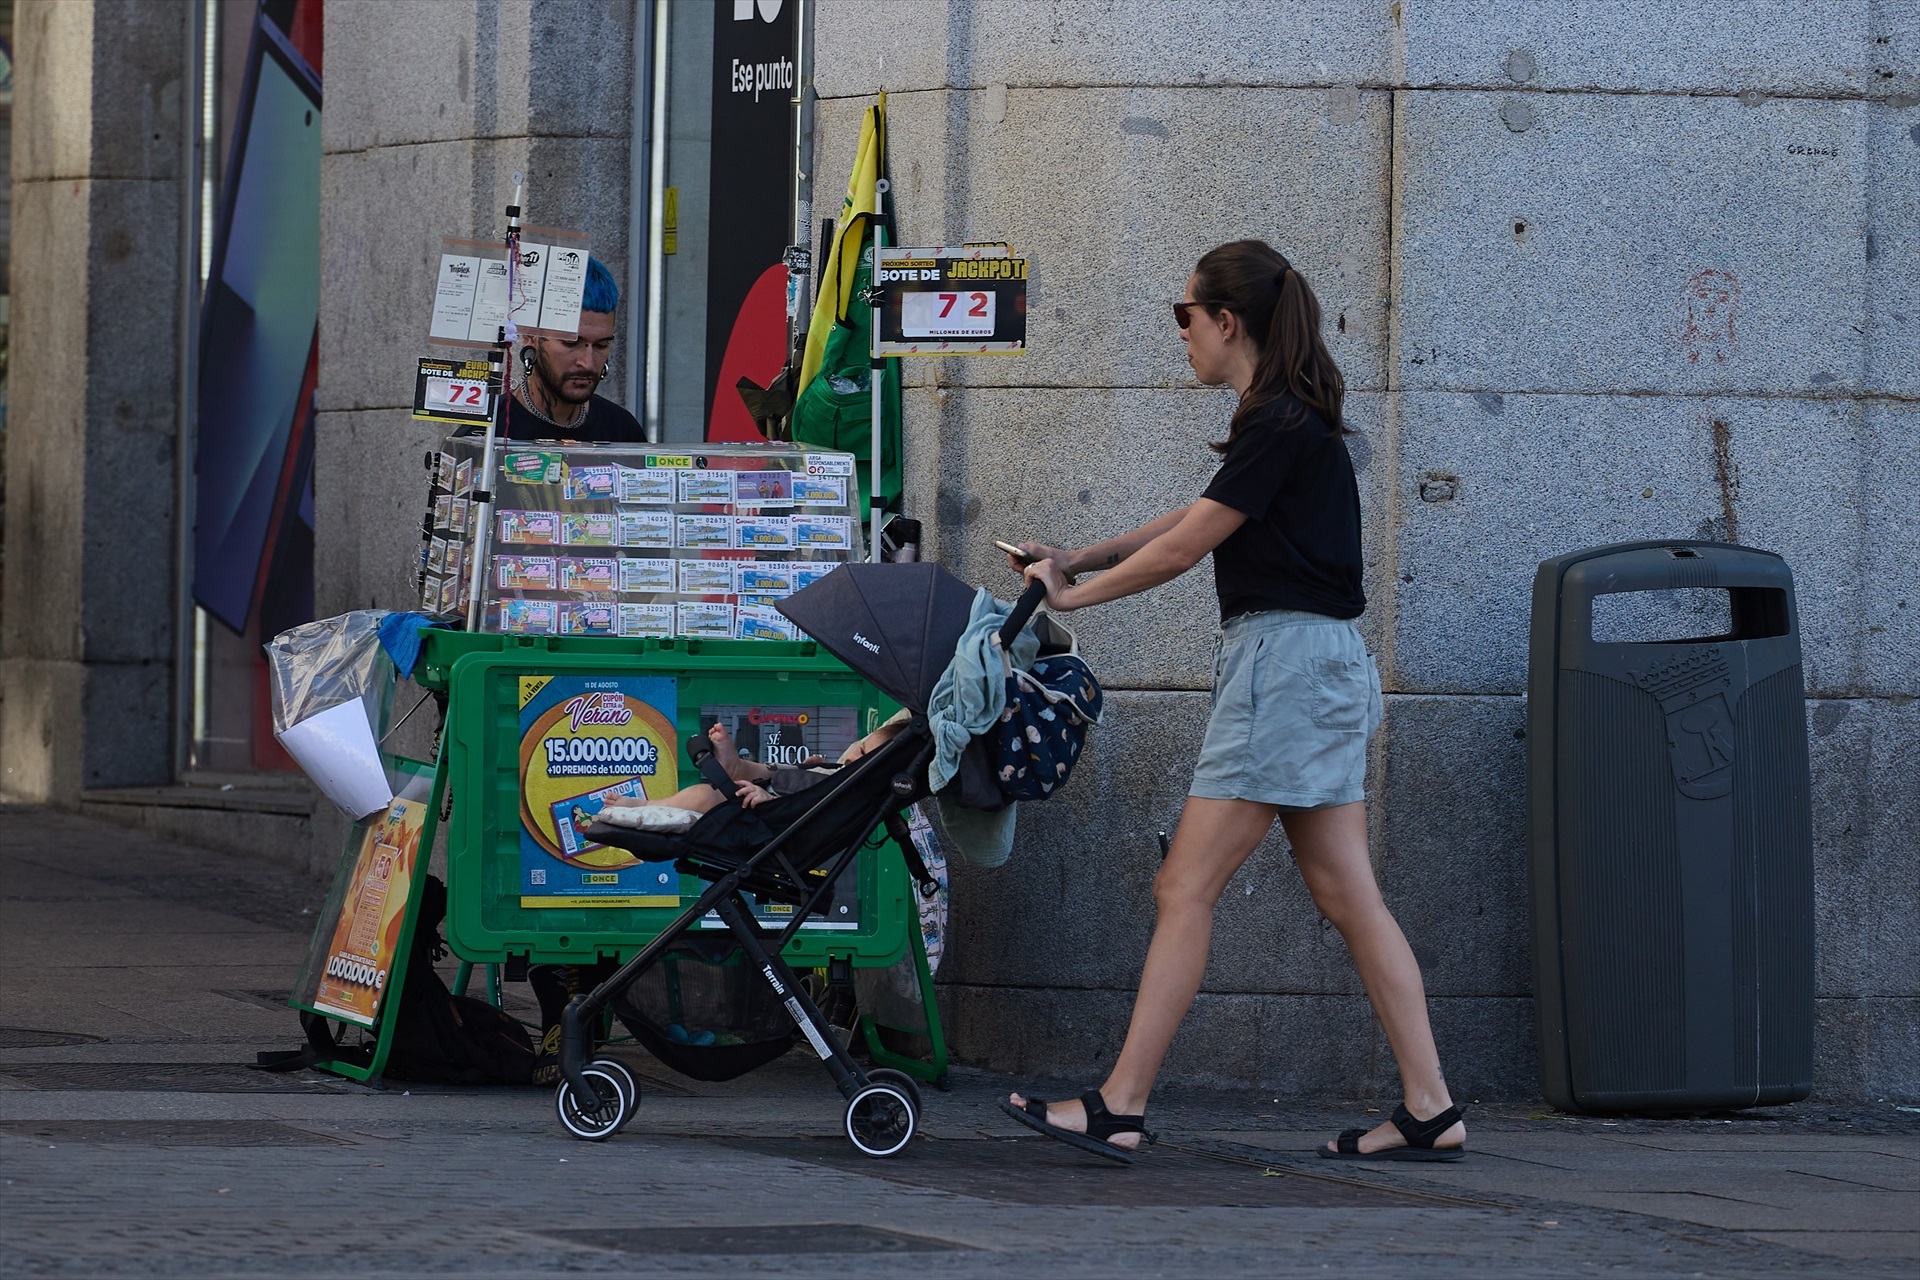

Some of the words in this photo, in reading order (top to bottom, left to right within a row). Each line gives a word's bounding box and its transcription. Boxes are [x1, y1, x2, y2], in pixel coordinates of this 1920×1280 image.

[732, 58, 753, 93] Ese
[755, 55, 793, 103] punto
[881, 259, 909, 267] PRÓXIMO
[946, 259, 1023, 279] JACKPOT
[880, 270, 918, 281] BOTE
[921, 270, 940, 281] DE
[939, 292, 988, 319] 72
[421, 368, 441, 376] BOTE
[465, 360, 489, 370] EURO
[449, 385, 482, 405] 72
[659, 458, 689, 466] ONCE
[525, 682, 533, 690] YA
[531, 681, 544, 694] VENTA
[602, 692, 623, 702] CUPÓN
[564, 692, 633, 731] Verano
[748, 708, 810, 726] CUPONAZO
[767, 731, 781, 745] SÉ
[545, 738, 657, 762] 15.000.000€
[767, 745, 810, 765] RICO
[547, 765, 561, 774] +10
[563, 765, 598, 774] PREMIOS
[598, 765, 609, 774] de
[609, 765, 655, 774] 1.000.000€
[762, 964, 785, 995] Terrain
